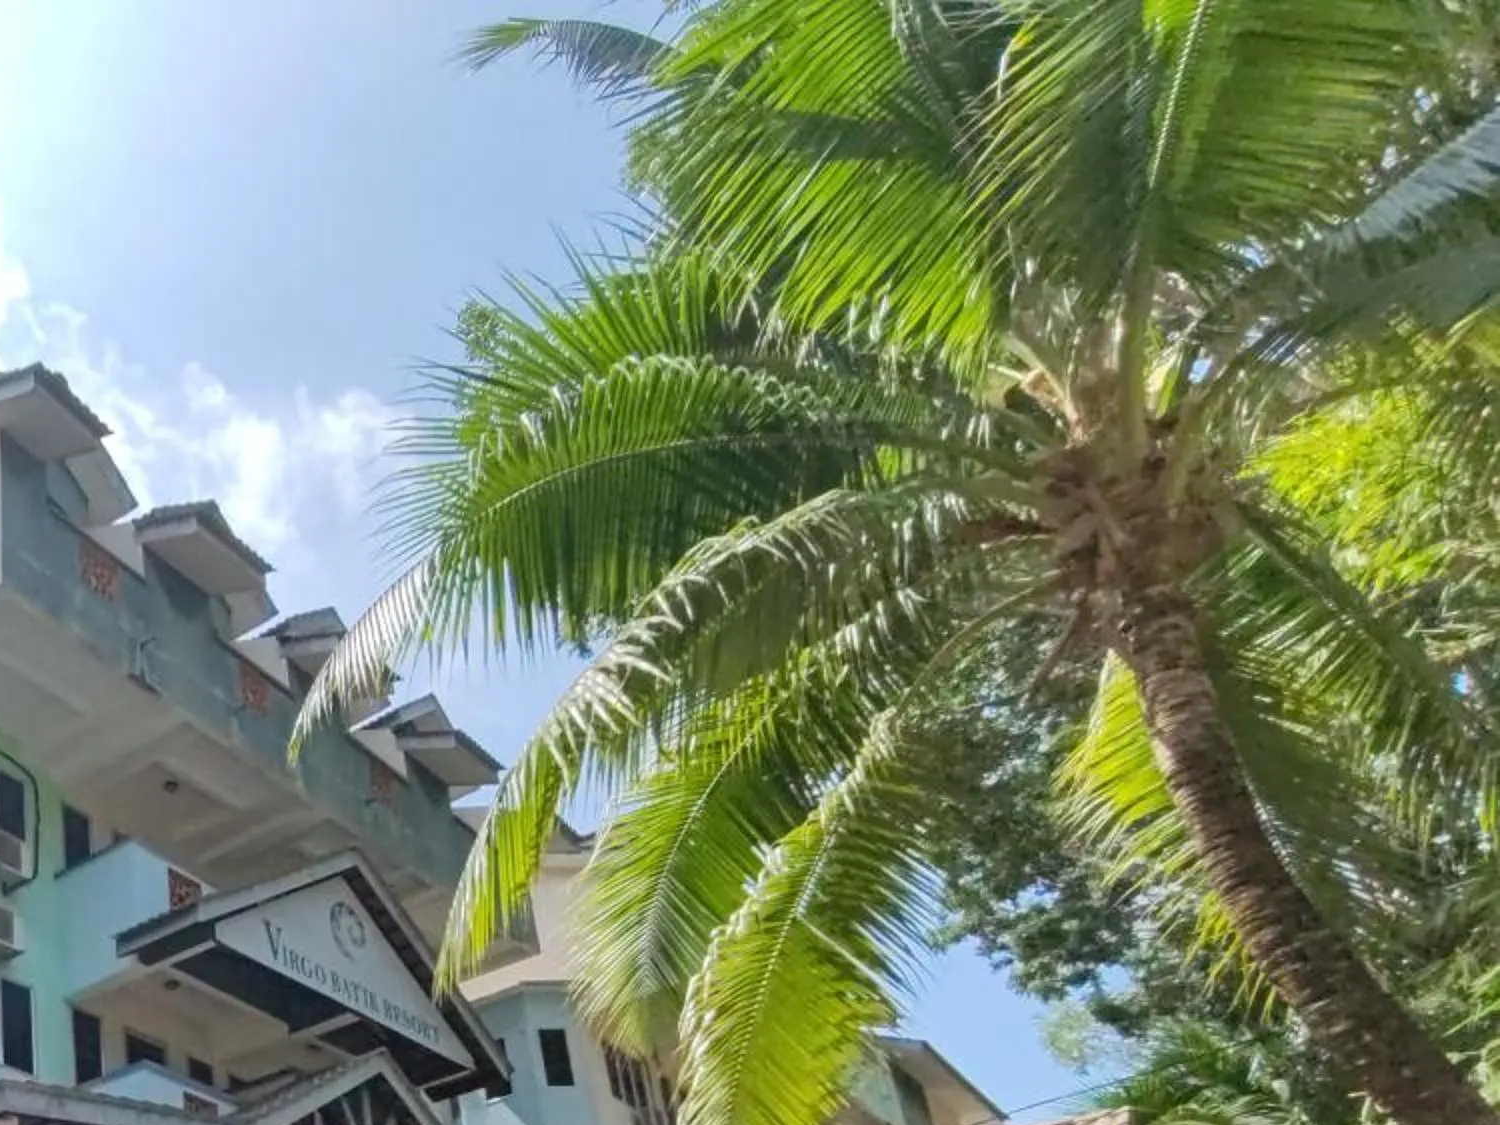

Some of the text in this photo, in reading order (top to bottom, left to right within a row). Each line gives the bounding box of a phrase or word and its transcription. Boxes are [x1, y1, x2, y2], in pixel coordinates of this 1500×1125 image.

[263, 918, 441, 1044] VIRGO BATIK RESORT
